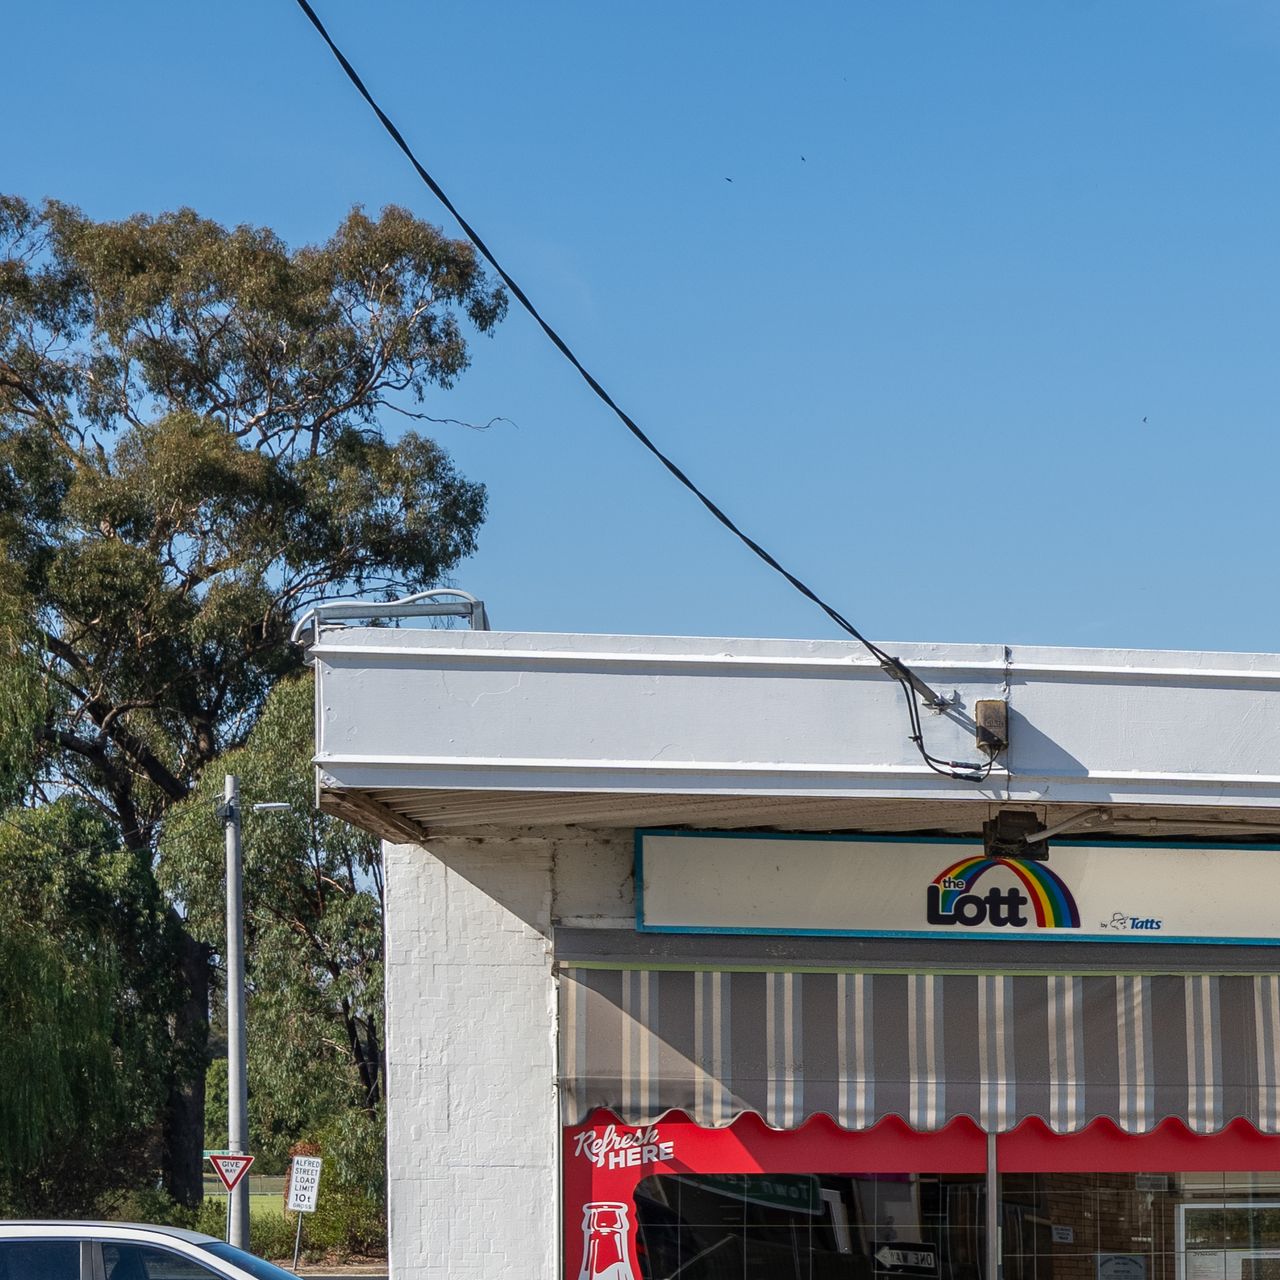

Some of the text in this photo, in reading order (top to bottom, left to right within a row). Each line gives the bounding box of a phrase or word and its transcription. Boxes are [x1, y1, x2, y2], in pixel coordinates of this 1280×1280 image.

[942, 877, 965, 889] the
[927, 885, 1028, 927] Lott
[1129, 916, 1162, 930] Tatts
[573, 1124, 660, 1168] Refresh
[608, 1141, 674, 1170] HERE
[295, 1160, 320, 1169] ALFRED
[294, 1168, 318, 1176] STREET
[294, 1184, 314, 1192] LIMIT
